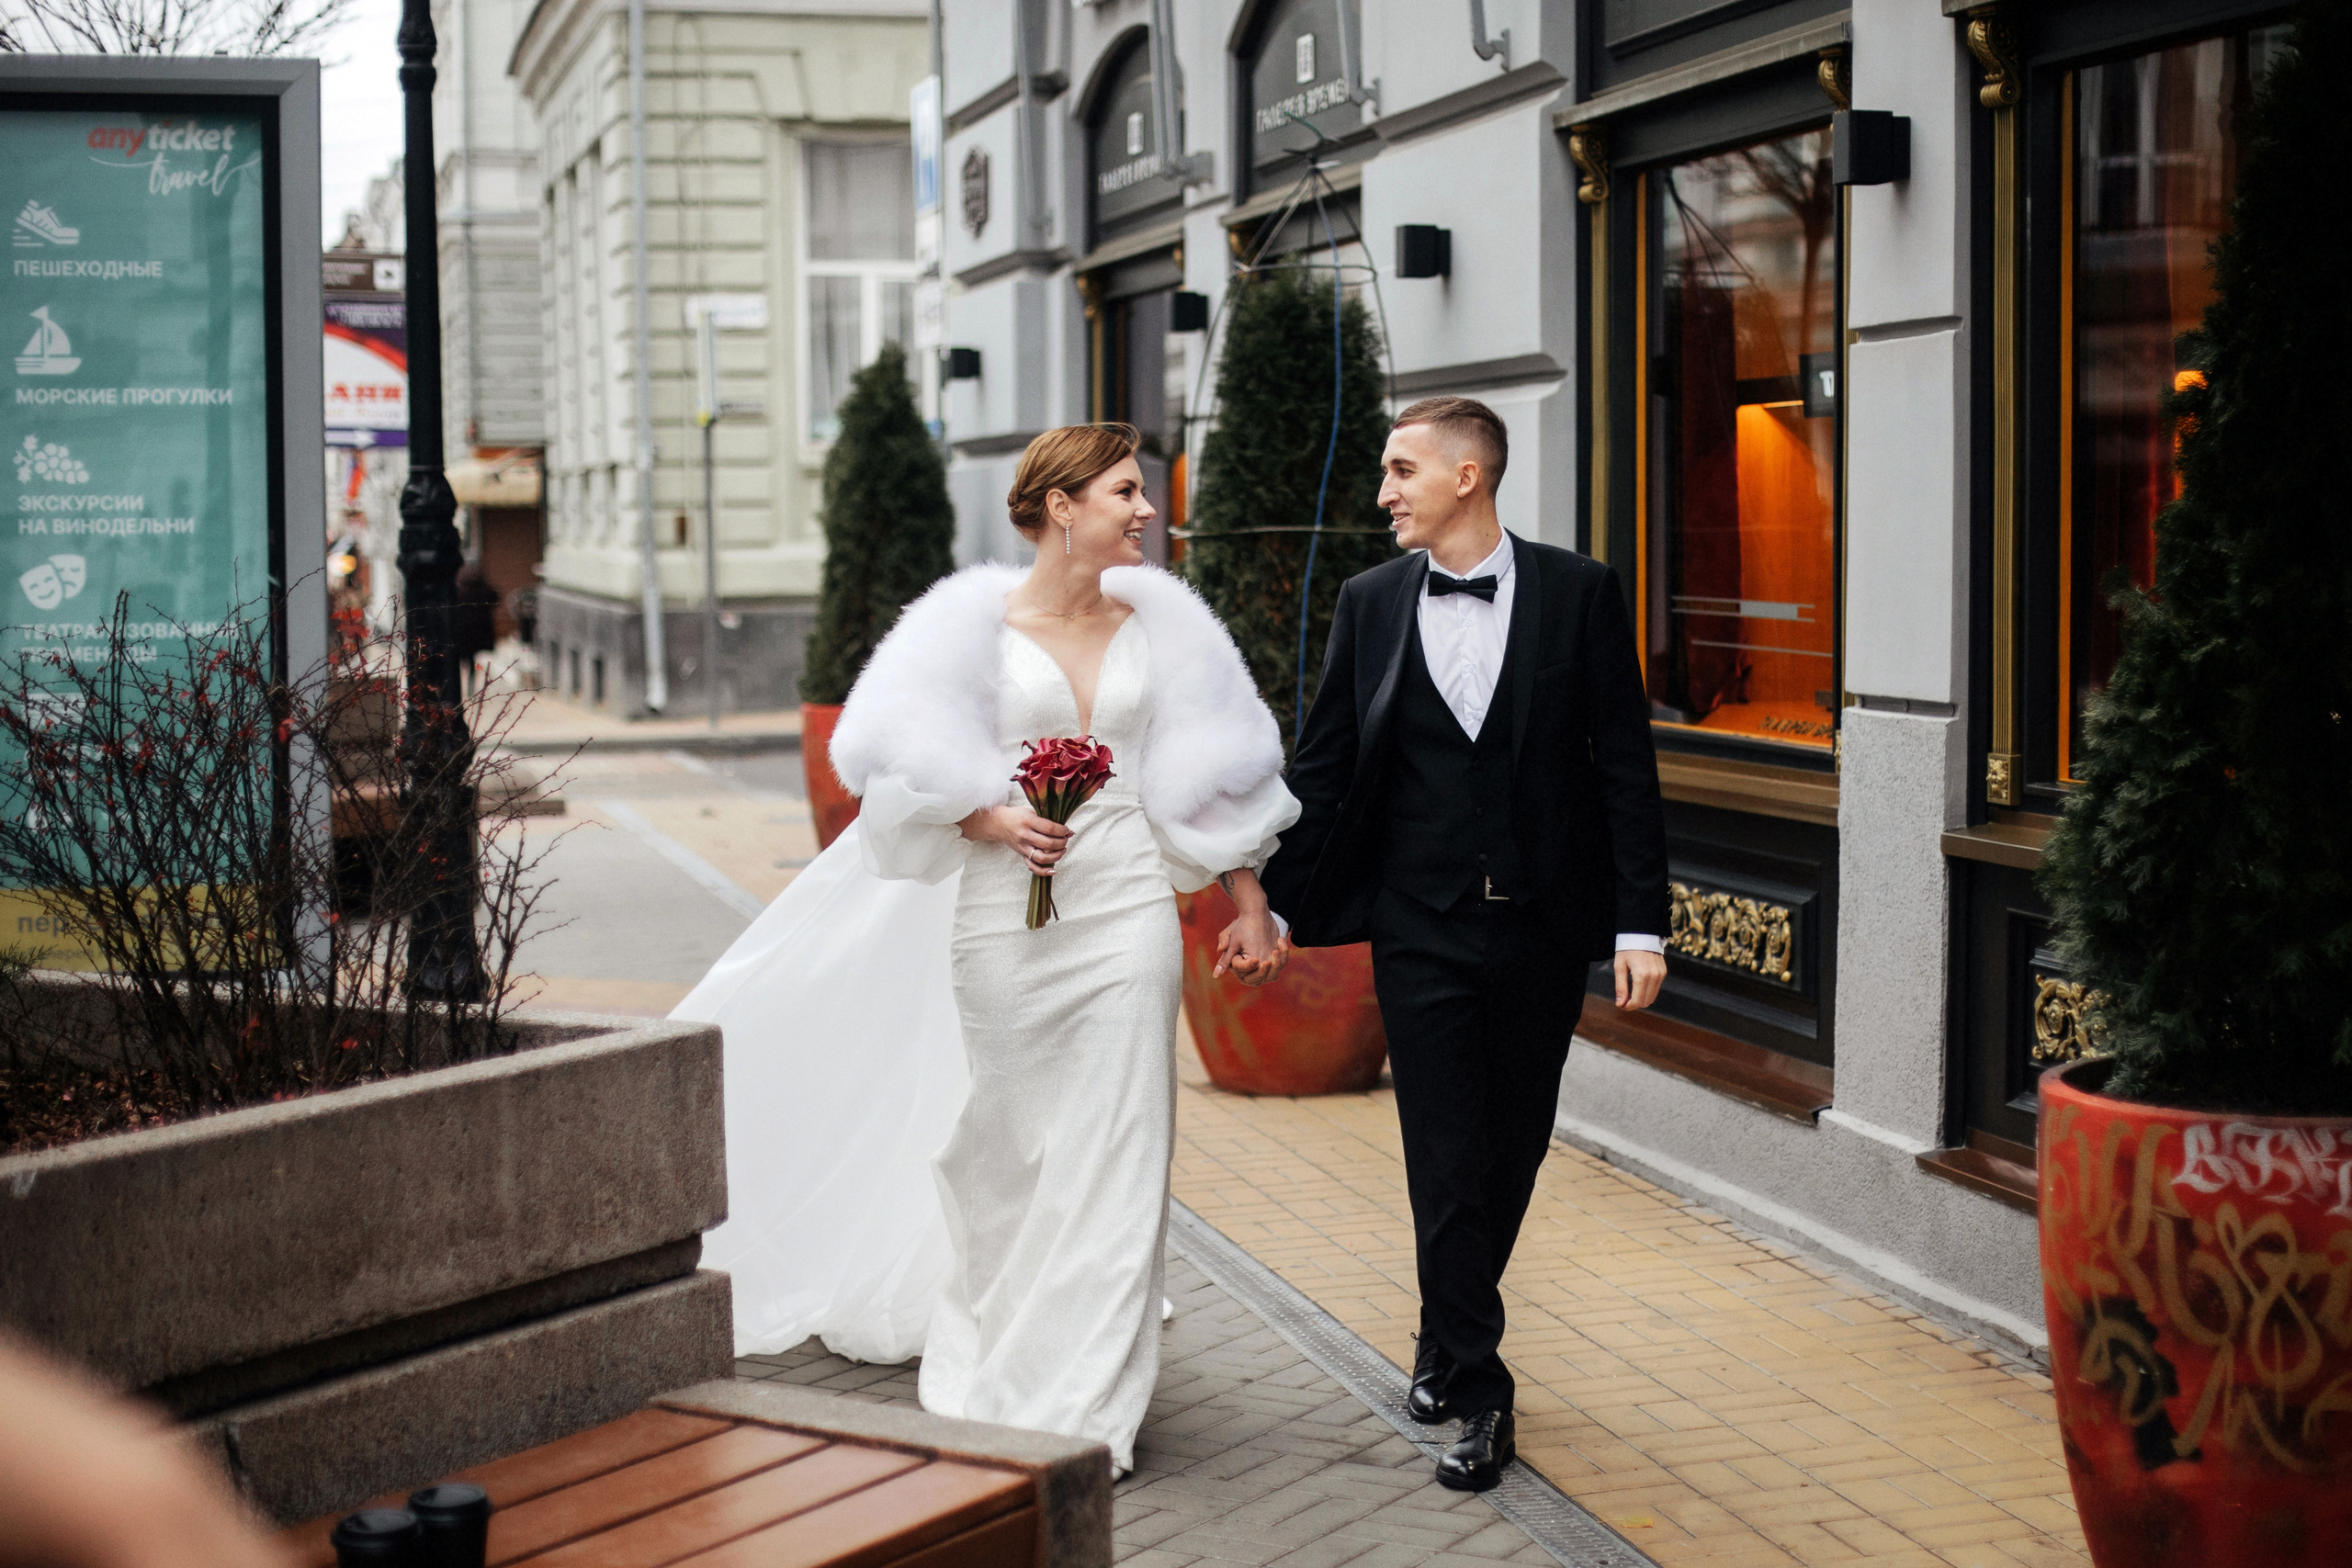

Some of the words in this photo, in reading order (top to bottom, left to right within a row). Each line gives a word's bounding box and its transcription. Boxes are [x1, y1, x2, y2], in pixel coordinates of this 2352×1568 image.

[147, 151, 232, 197] travel
[13, 259, 164, 281] ПЕШЕХОДНЫЕ
[15, 388, 118, 405] МОРСКИЕ
[122, 388, 233, 405] ПРОГУЛКИ
[17, 494, 145, 513] ЭКСКУРСИИ
[17, 518, 47, 535] НА
[51, 517, 196, 538] ВИНОДЕЛЬНИ
[20, 646, 157, 665] ПРОМЕНДЫ
